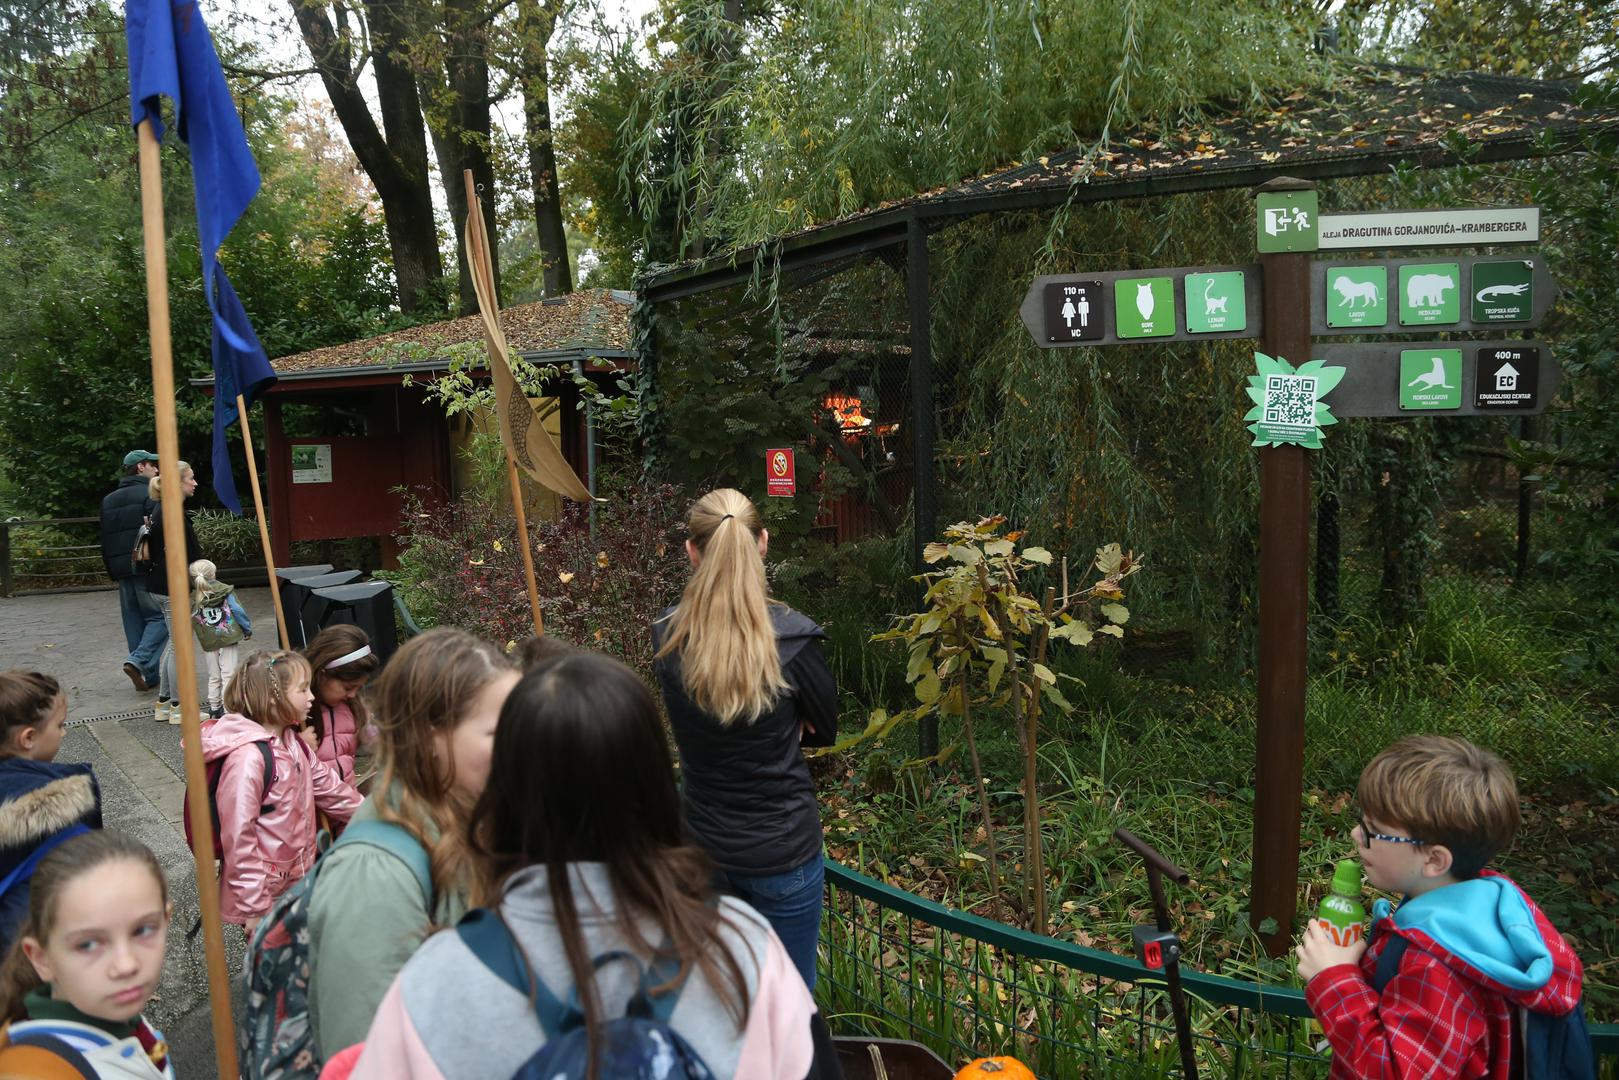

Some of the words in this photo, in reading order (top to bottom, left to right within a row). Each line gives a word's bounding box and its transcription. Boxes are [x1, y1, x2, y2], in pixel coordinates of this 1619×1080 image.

[1322, 231, 1341, 239] ALEJA
[1342, 226, 1392, 238] DRAGUTINA
[1063, 286, 1077, 295] 110
[1484, 307, 1506, 315] TROPSKA
[1070, 328, 1082, 338] WC
[1494, 350, 1512, 360] 400
[1499, 375, 1514, 387] EC
